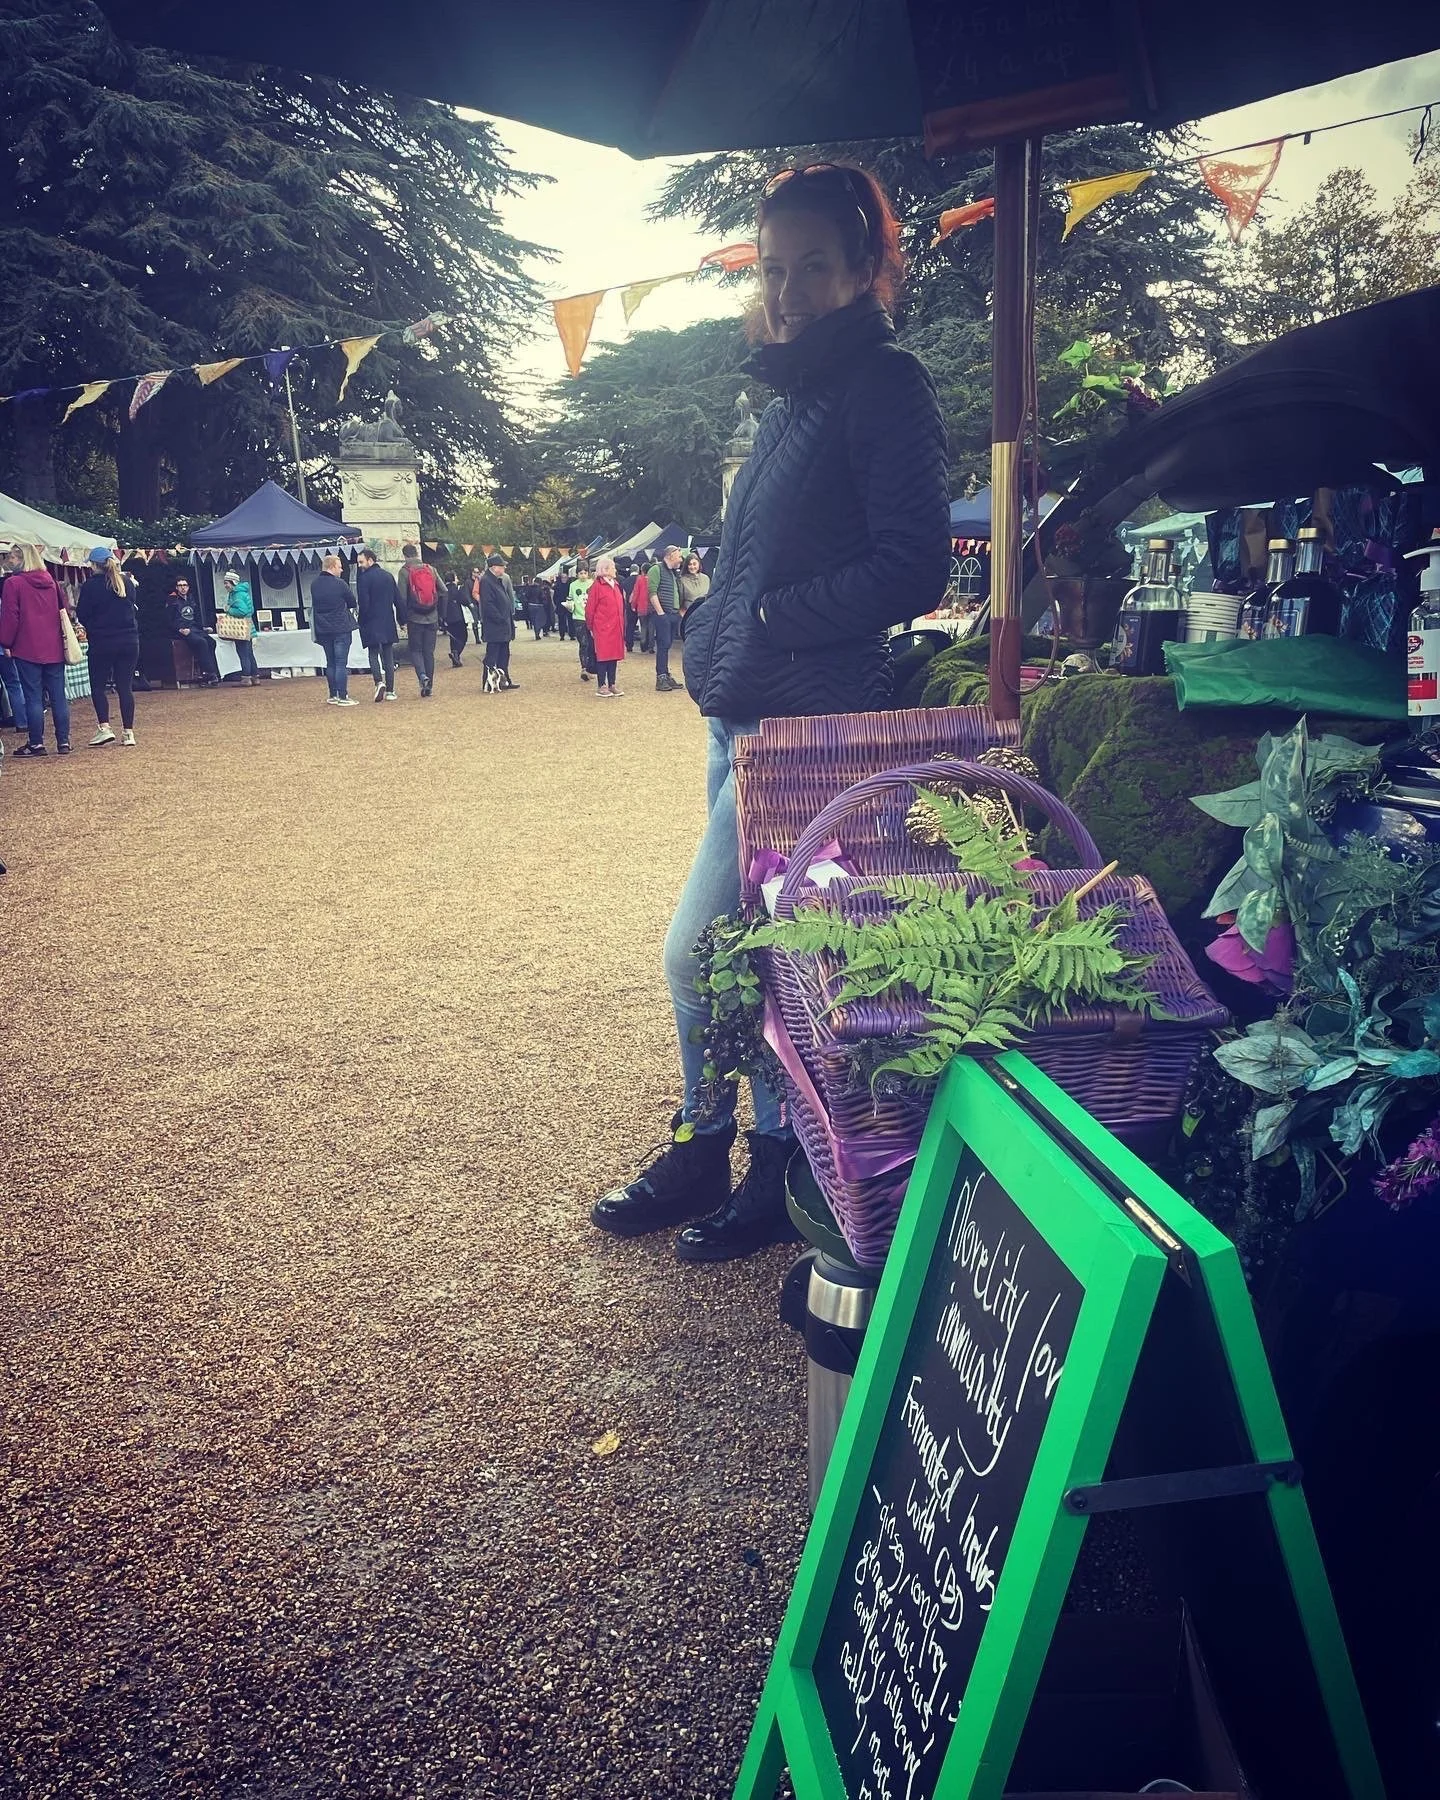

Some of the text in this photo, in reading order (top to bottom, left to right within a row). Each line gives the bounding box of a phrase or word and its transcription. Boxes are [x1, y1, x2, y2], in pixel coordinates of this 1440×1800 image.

[936, 1281, 1013, 1477] immunity
[906, 1478, 963, 1631] with CBD
